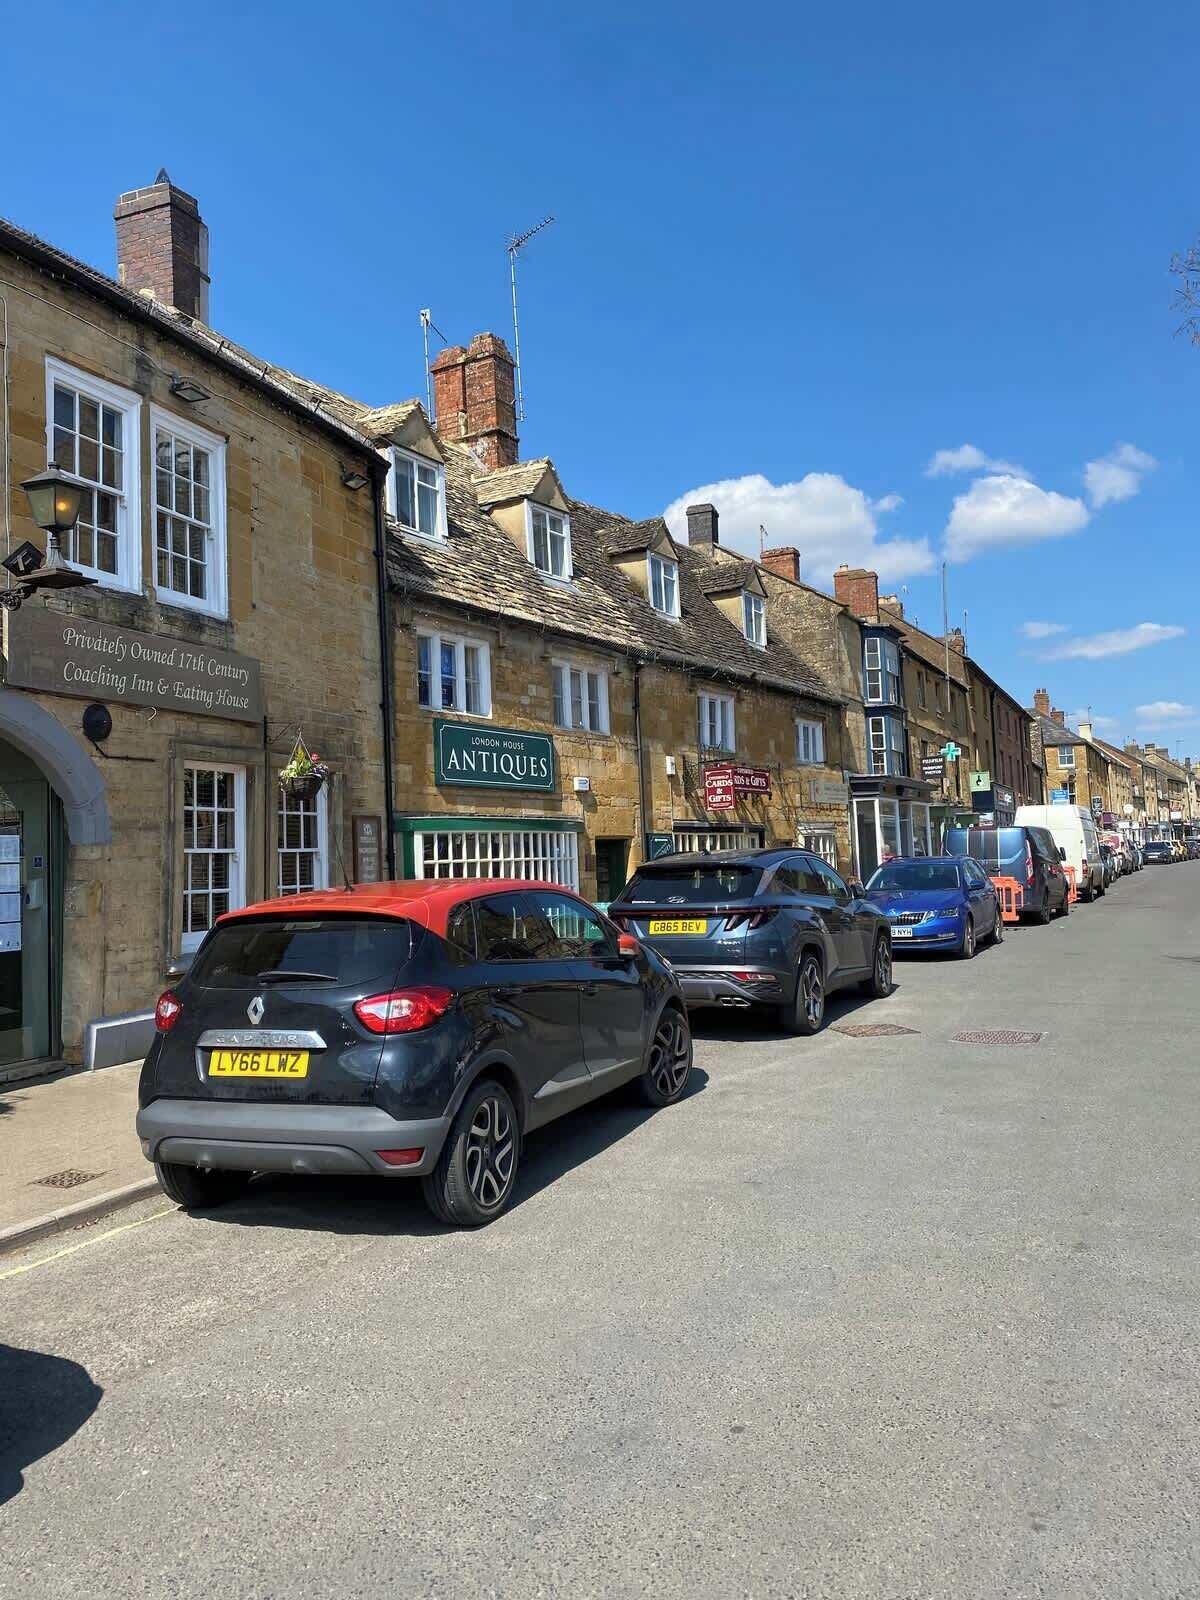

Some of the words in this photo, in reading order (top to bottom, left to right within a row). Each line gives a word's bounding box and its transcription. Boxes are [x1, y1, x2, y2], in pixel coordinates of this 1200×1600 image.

[62, 627, 127, 662] Privately
[130, 641, 177, 666] Owned
[178, 652, 204, 673] 17th
[207, 658, 249, 686] Century
[63, 661, 127, 695] Coaching
[130, 673, 154, 693] Inn
[157, 678, 169, 694] &
[173, 681, 213, 708] Eating
[215, 688, 249, 709] House
[471, 736, 500, 747] LONDON
[502, 741, 525, 751] HOUSE
[447, 747, 548, 780] ANTIQUES
[705, 779, 733, 788] CARDS
[708, 794, 732, 802] GIFTS
[681, 921, 701, 932] BEV
[897, 928, 912, 936] NYH
[216, 1052, 260, 1072] LY66
[265, 1053, 302, 1073] LWZ
